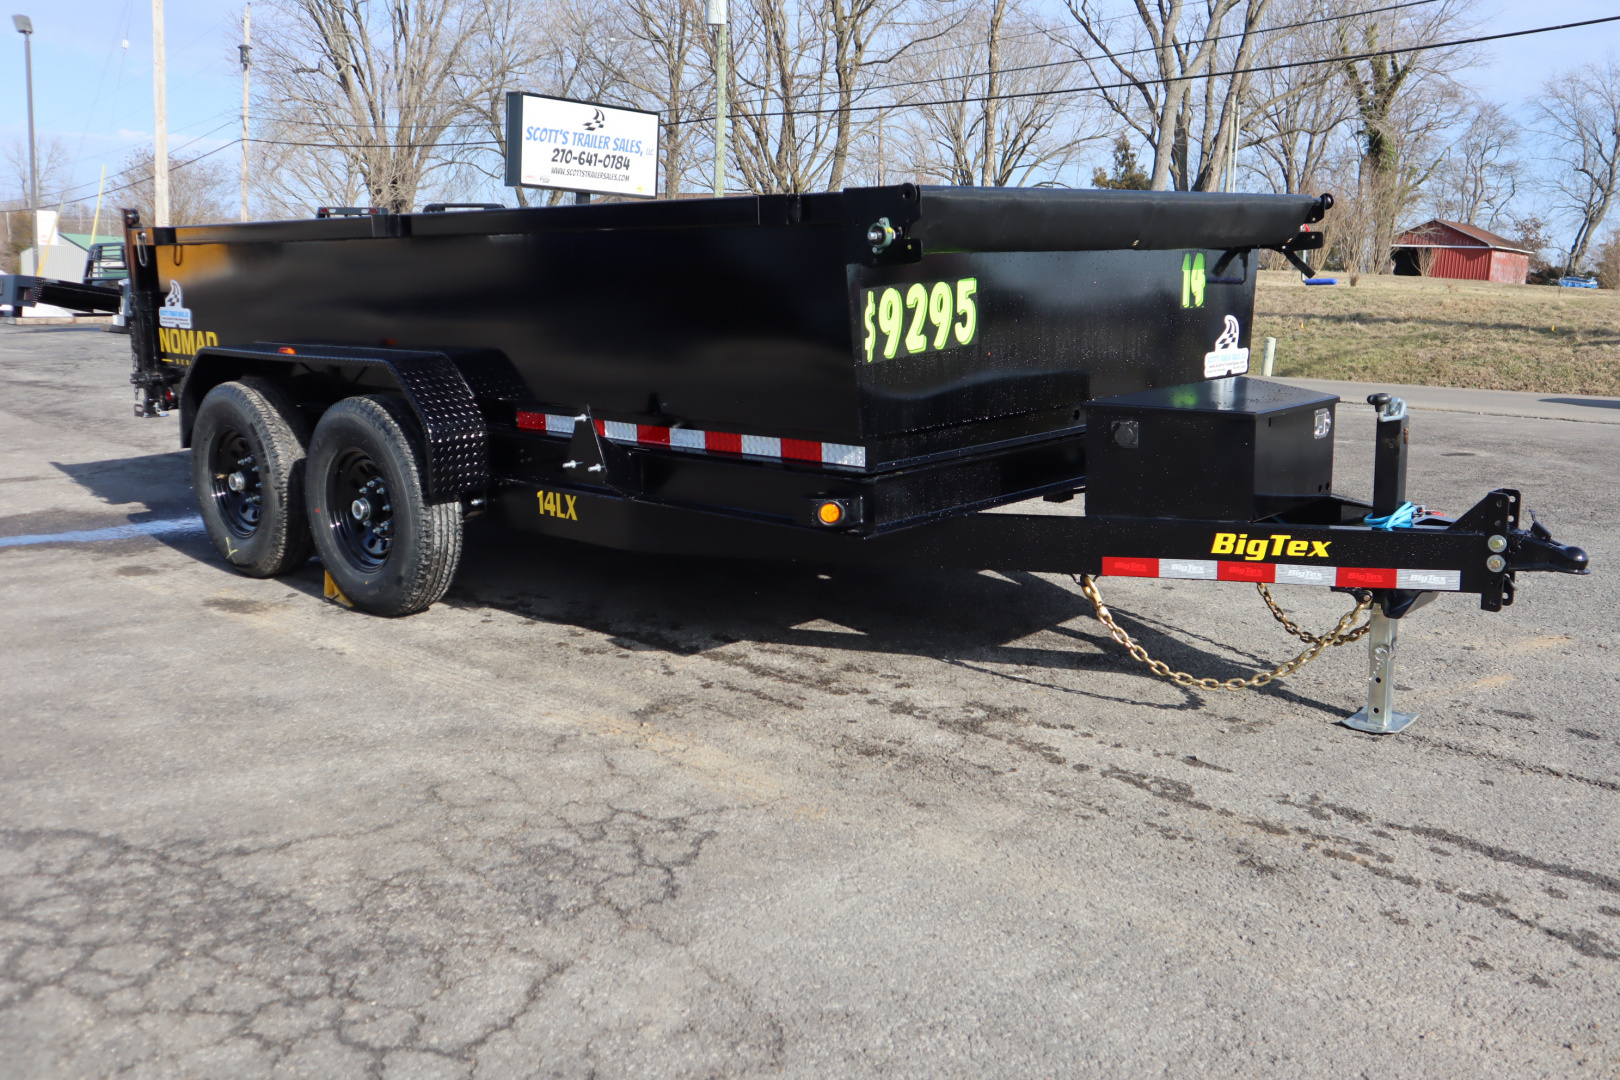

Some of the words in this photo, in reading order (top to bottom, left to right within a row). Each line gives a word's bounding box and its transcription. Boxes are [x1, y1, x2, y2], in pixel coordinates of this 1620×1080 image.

[526, 126, 569, 145] SCOTT'S
[572, 132, 611, 150] TRAILER
[612, 137, 643, 157] SALES,
[551, 148, 631, 170] 270-641-0784
[550, 167, 630, 182] WWW.SCOTTSTRAILERSALES.COM
[1182, 252, 1206, 308] 14
[864, 277, 977, 363] $9295
[158, 327, 218, 356] NOMAD
[536, 490, 578, 521] 14LX
[1210, 532, 1332, 561] BigTex
